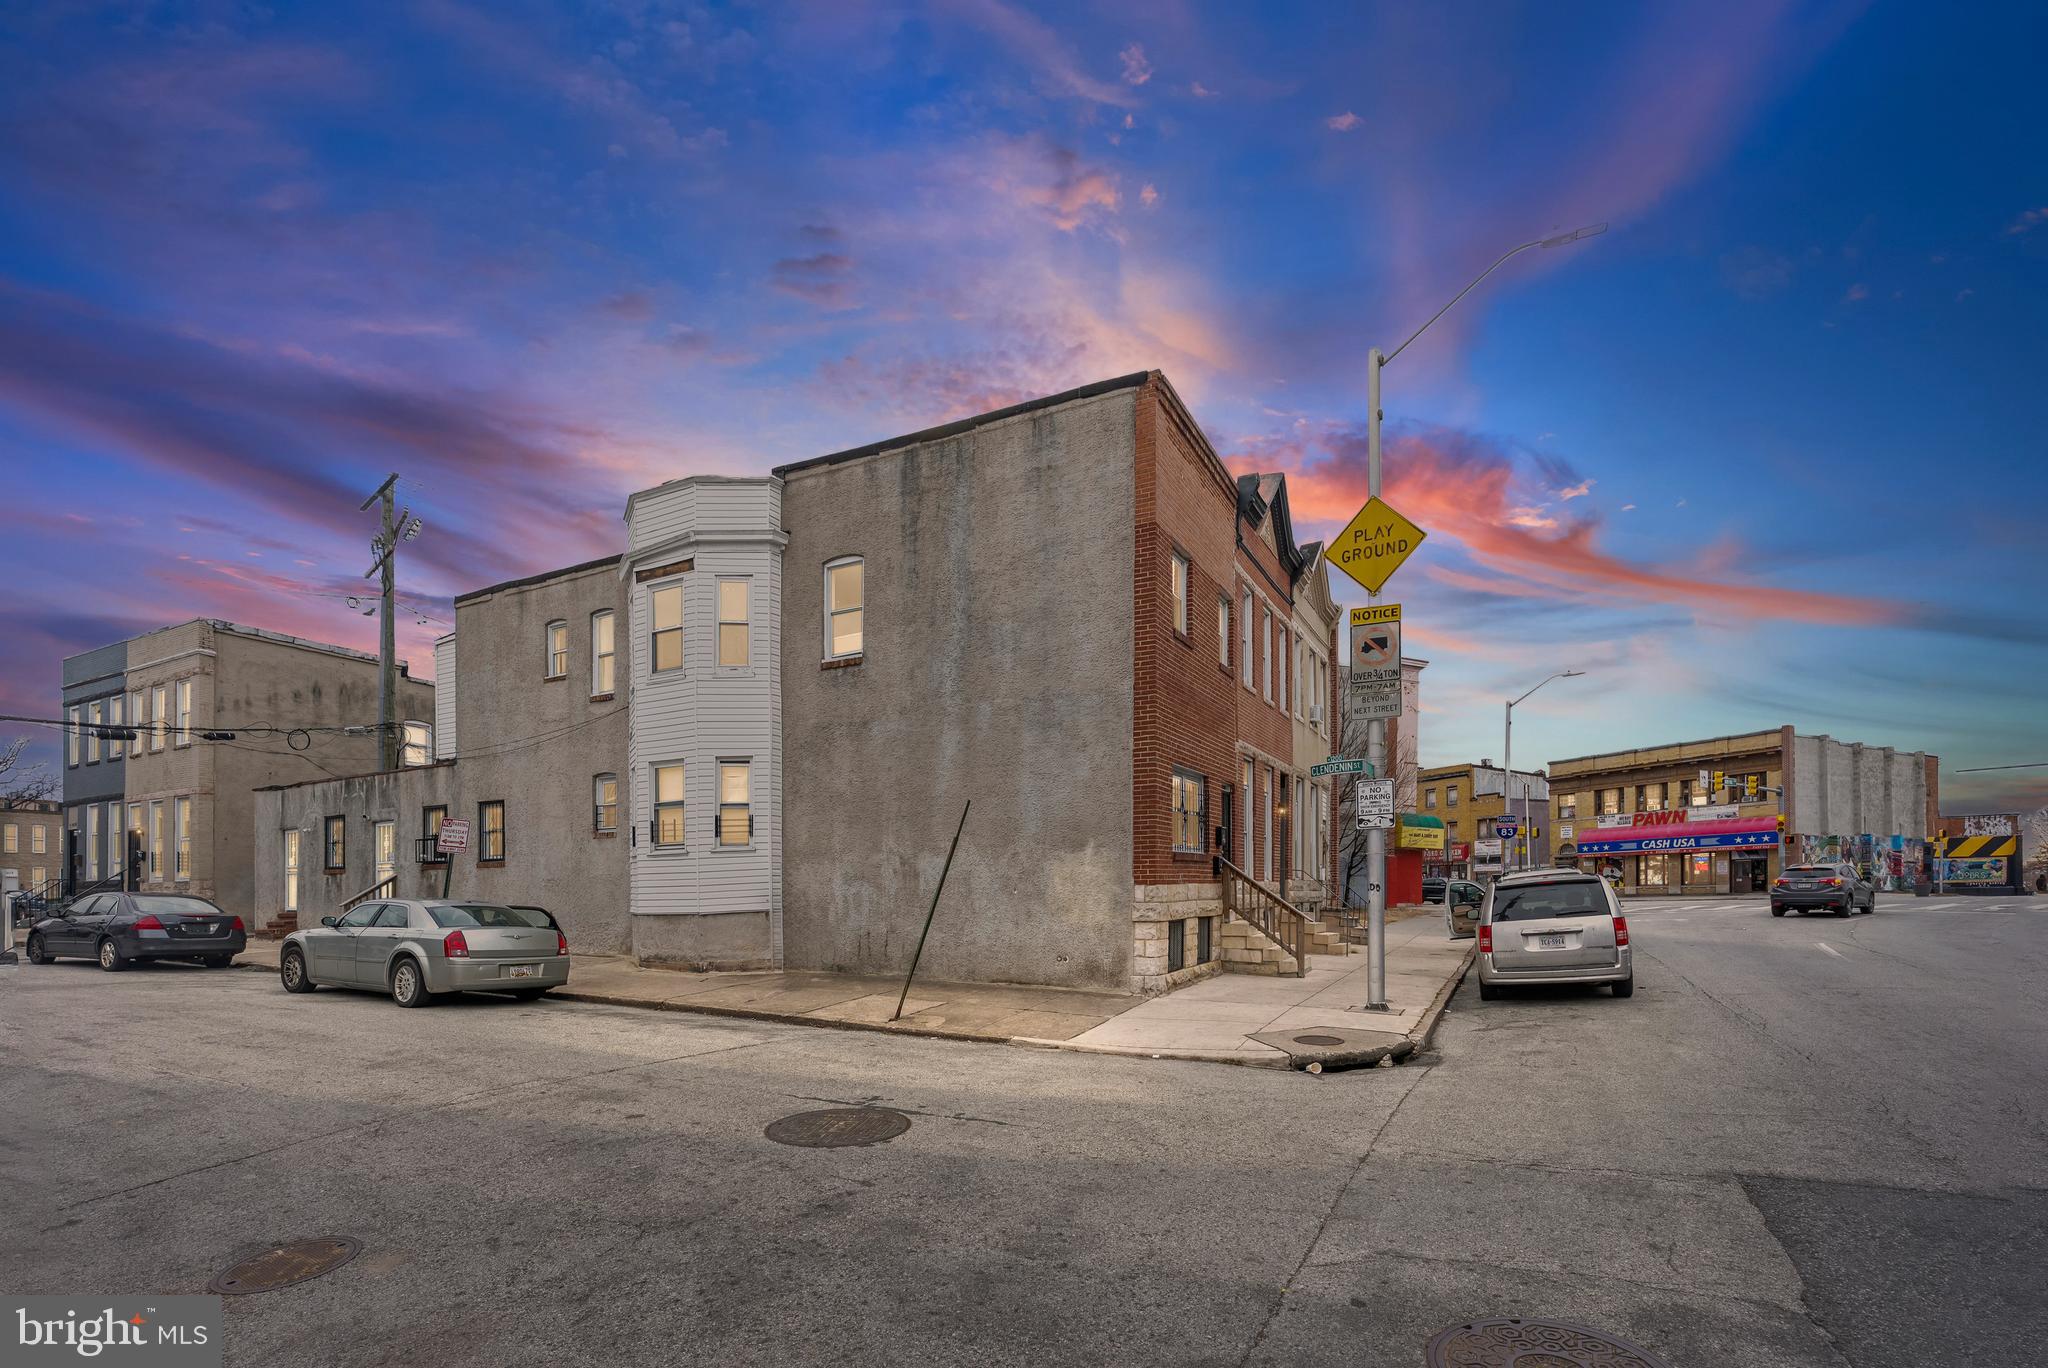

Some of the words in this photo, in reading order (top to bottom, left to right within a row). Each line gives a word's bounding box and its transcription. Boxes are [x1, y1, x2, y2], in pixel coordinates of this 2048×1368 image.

[1354, 523, 1394, 544] PLAY
[1341, 539, 1408, 563] GROUND
[1353, 608, 1399, 621] NOTICE
[1353, 672, 1373, 681] OVER
[1383, 669, 1399, 679] TON
[1361, 694, 1390, 704] BEYOND
[1353, 706, 1371, 715] NEXT
[1373, 704, 1398, 713] STREET
[1311, 762, 1353, 776] CLENDENIN
[1369, 786, 1382, 794] NO
[1359, 793, 1391, 801] PARKING
[443, 819, 453, 827] NO
[1632, 810, 1688, 827] PAWN
[1641, 839, 1670, 849] CASH
[1672, 837, 1696, 848] USA
